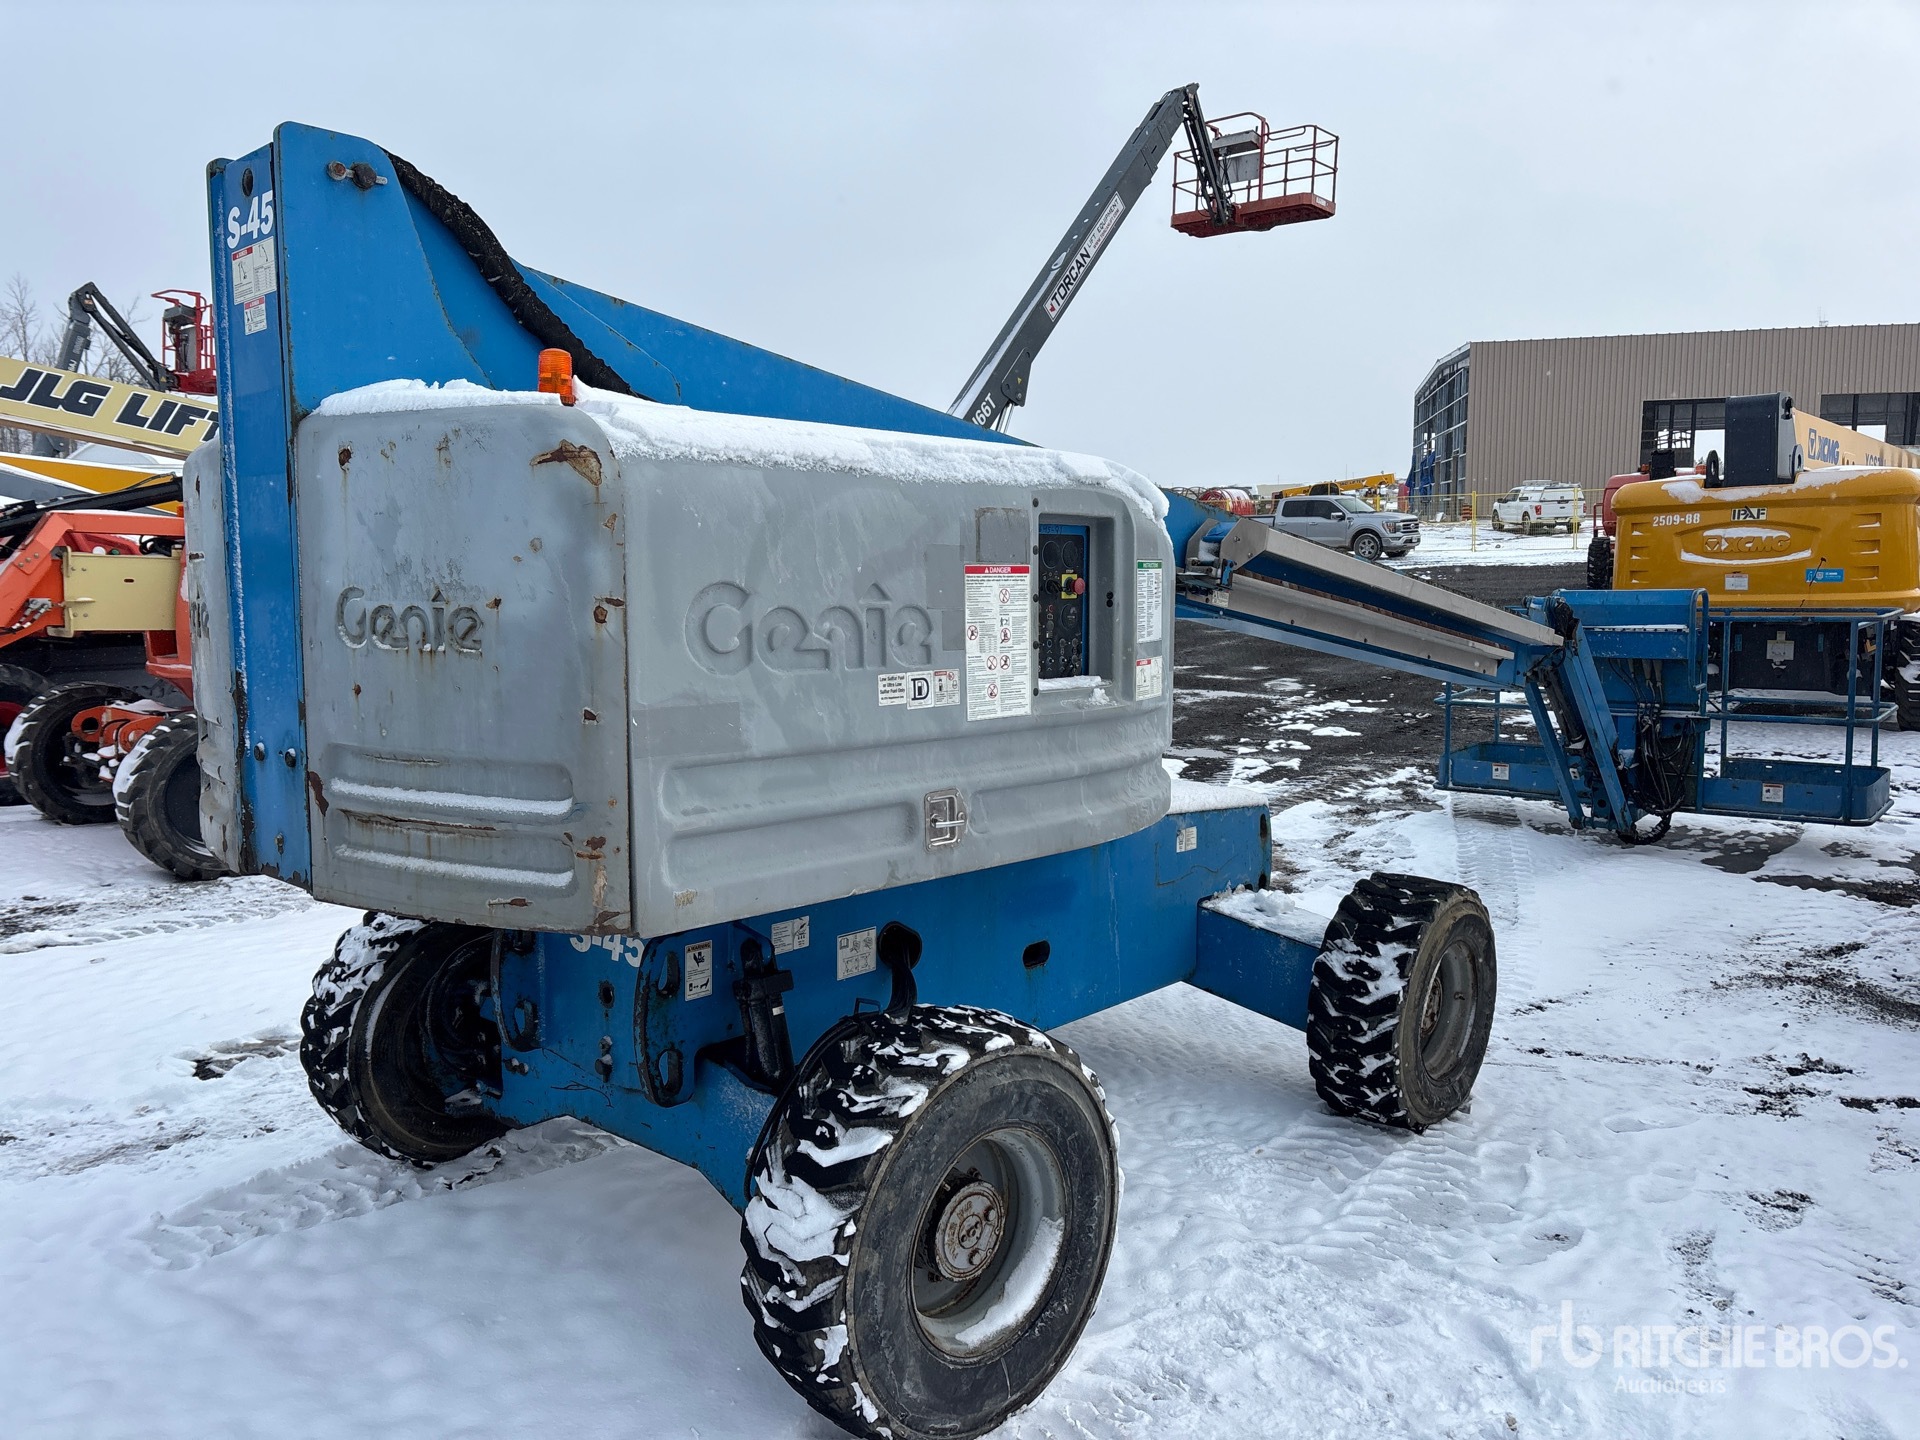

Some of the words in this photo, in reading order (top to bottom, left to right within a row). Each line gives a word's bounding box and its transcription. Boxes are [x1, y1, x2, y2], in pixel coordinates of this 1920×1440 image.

[227, 190, 274, 249] S-45
[1051, 247, 1091, 307] TORCAN
[1087, 233, 1098, 249] LIFT
[1096, 198, 1119, 235] EQUIPMENT
[0, 367, 113, 417] JLG
[1816, 436, 1840, 465] XCMG
[1652, 512, 1701, 527] 2509-88
[1732, 506, 1767, 521] IPAF
[1722, 535, 1791, 552] XCMG
[990, 566, 1012, 574] DANGER
[336, 585, 484, 652] Genie
[684, 581, 933, 678] Genie
